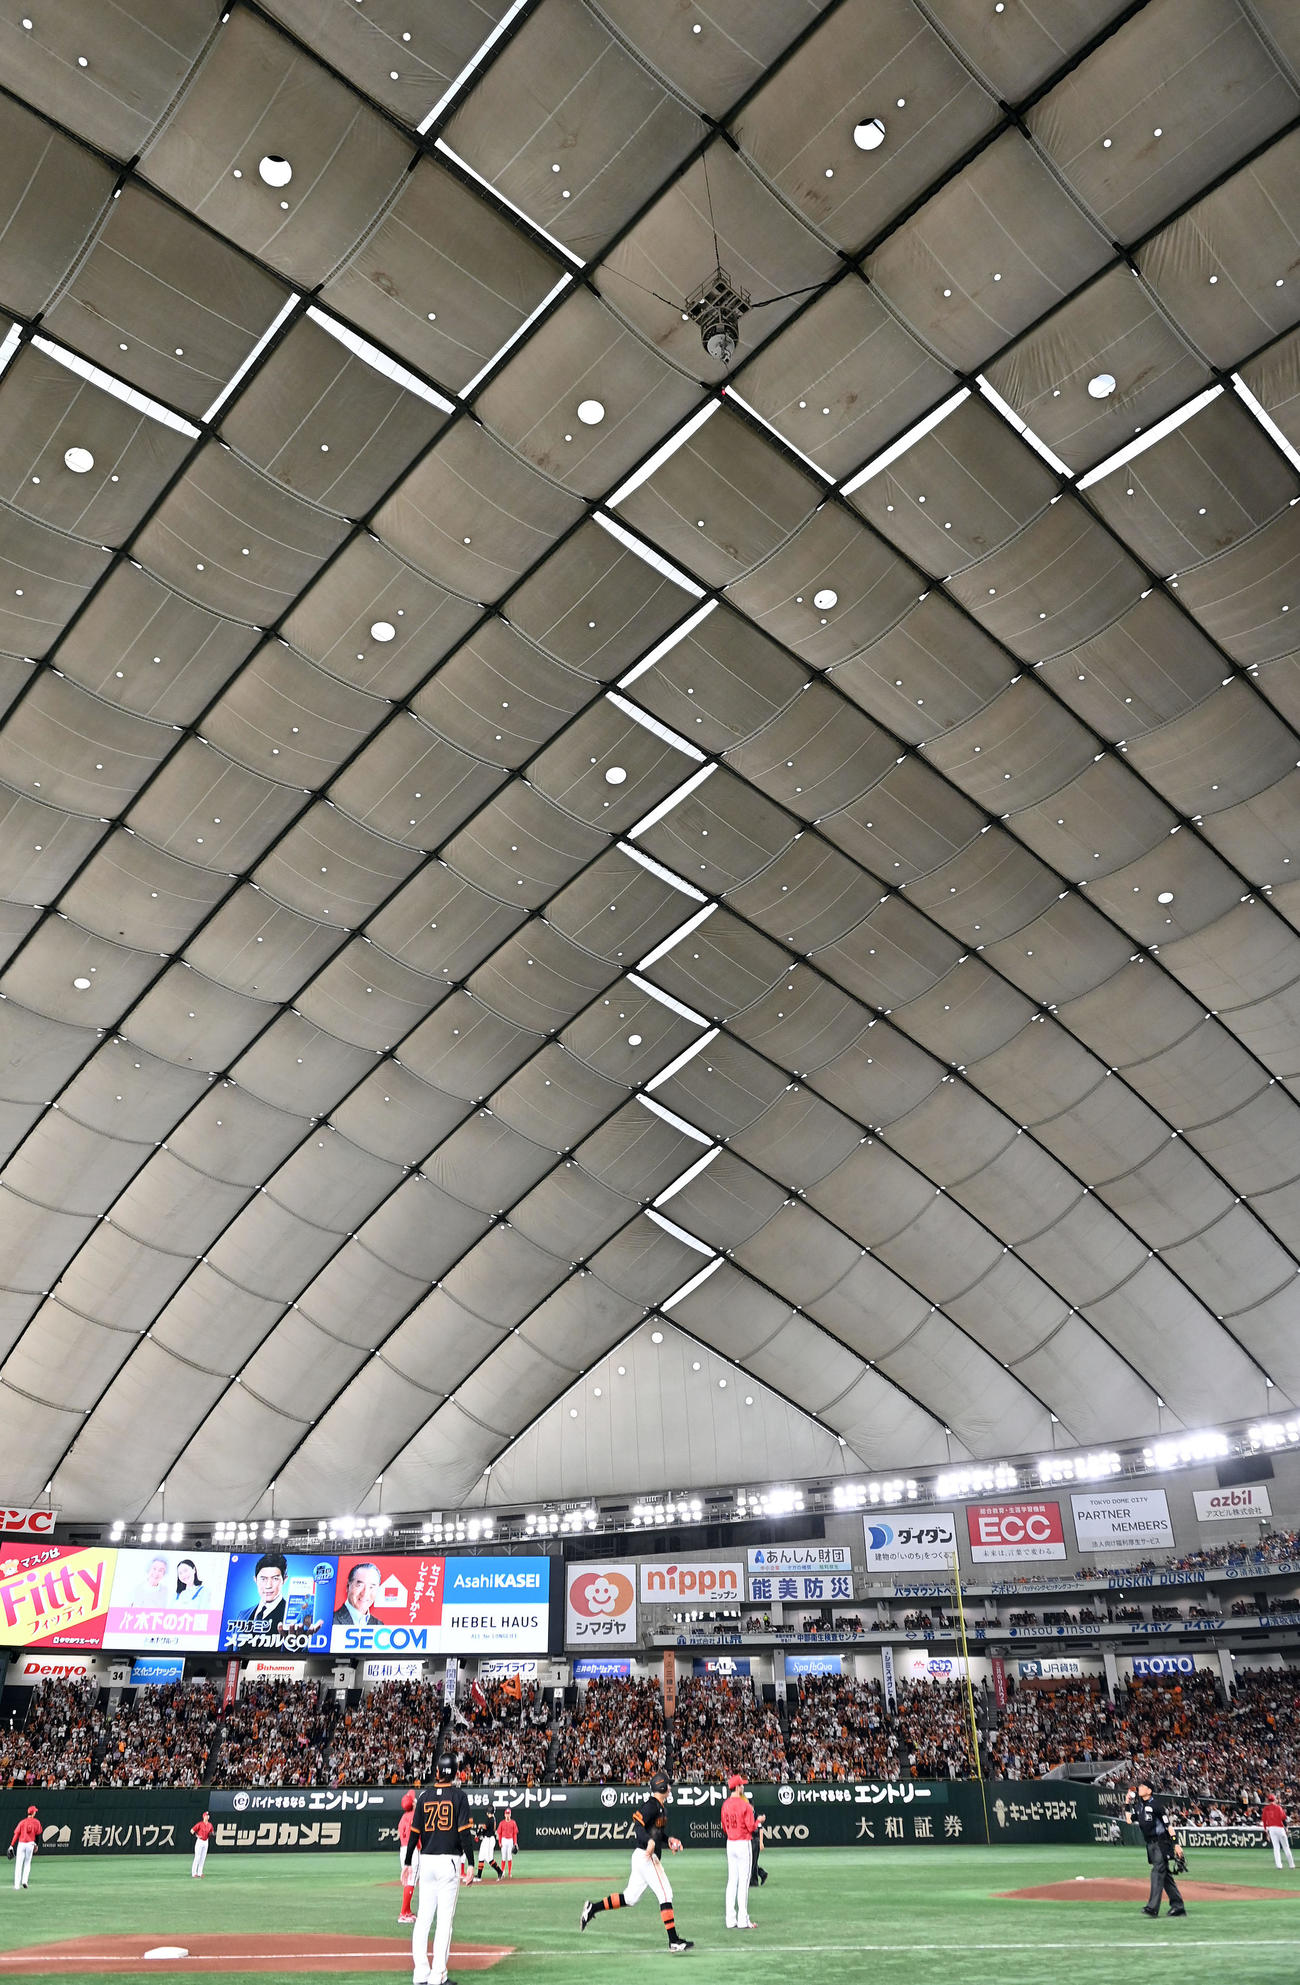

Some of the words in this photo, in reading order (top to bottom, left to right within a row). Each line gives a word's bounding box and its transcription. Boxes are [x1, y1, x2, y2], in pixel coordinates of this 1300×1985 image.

[1210, 1490, 1252, 1507] azbil
[1078, 1509, 1131, 1520] PARTNER
[979, 1515, 1051, 1542] ECC
[1112, 1520, 1168, 1532] MEMBERS
[898, 1527, 952, 1544] ダイダン
[21, 1547, 60, 1568] マスクは
[767, 1549, 844, 1563] あんしん財団
[648, 1566, 737, 1595] nippn
[752, 1577, 850, 1599] 能美防災
[1109, 1575, 1153, 1589] DUSKIN
[1160, 1571, 1205, 1585] DUSKIN
[0, 1562, 103, 1627] Fitty
[711, 1591, 738, 1600] ニップン
[27, 1606, 83, 1634] フィッティ
[226, 1620, 272, 1632] アリナミン
[451, 1616, 496, 1628] HEBEL
[501, 1616, 538, 1628] HAUS
[576, 1619, 626, 1635] シマダヤ
[1129, 1622, 1172, 1632] アイホン
[1182, 1620, 1225, 1631] アイホン
[345, 1628, 427, 1649] SECOM
[24, 1663, 86, 1679] Denyo
[257, 1663, 295, 1671] Bishamon
[367, 1664, 417, 1676] 昭和大学
[482, 1662, 535, 1672] ニッテイライフ
[1023, 1663, 1038, 1672] JR
[1044, 1662, 1078, 1673] JR貨物
[1135, 1657, 1193, 1675] TOTO
[113, 1672, 123, 1680] 34
[340, 1673, 345, 1681] 3
[557, 1672, 561, 1680] 1
[252, 1795, 305, 1809] バイトするなら
[308, 1790, 384, 1810] エントリー
[493, 1788, 567, 1808] エントリー
[797, 1789, 852, 1802] バイトするなら
[854, 1783, 931, 1803] エントリー
[423, 1801, 454, 1832] 79
[1009, 1800, 1077, 1820] キューピーマヨネーズ
[215, 1822, 341, 1846] ビックカメラ
[536, 1827, 571, 1836] KONAMI
[690, 1822, 708, 1831] Good
[710, 1821, 722, 1830] luc
[855, 1815, 963, 1839] 大和証券
[81, 1824, 175, 1847] 積水ハウス
[690, 1830, 709, 1839] Good
